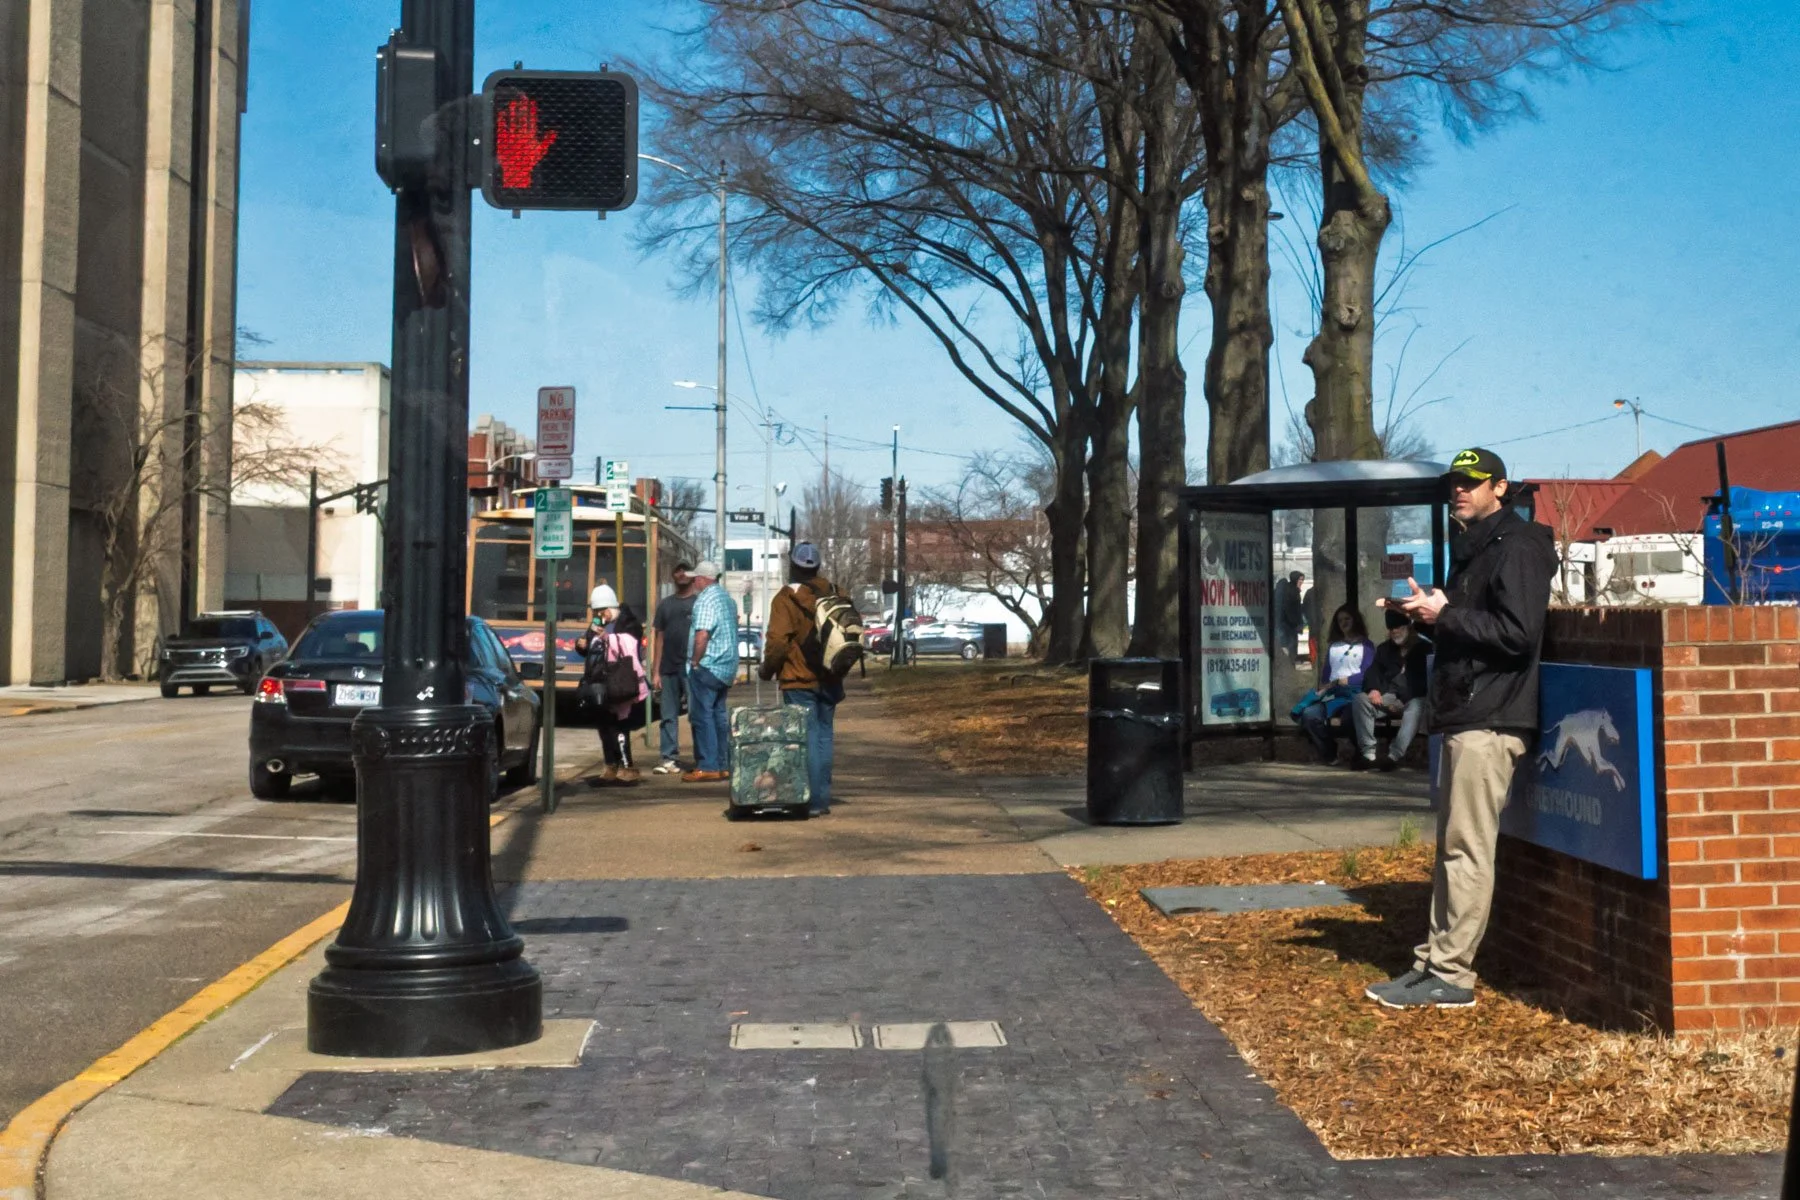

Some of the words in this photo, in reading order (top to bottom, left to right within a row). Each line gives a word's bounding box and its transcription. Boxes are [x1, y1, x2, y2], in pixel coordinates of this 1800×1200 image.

[549, 393, 564, 407] NO
[540, 408, 573, 421] PARKING
[607, 464, 614, 478] 2
[536, 492, 545, 509] 2
[1224, 539, 1263, 571] METS
[1200, 579, 1226, 606] NOW
[1228, 579, 1266, 606] HIRING
[1216, 616, 1228, 626] BUS
[1221, 630, 1257, 641] MECHANICS
[1525, 783, 1602, 826] GREYHOUND
